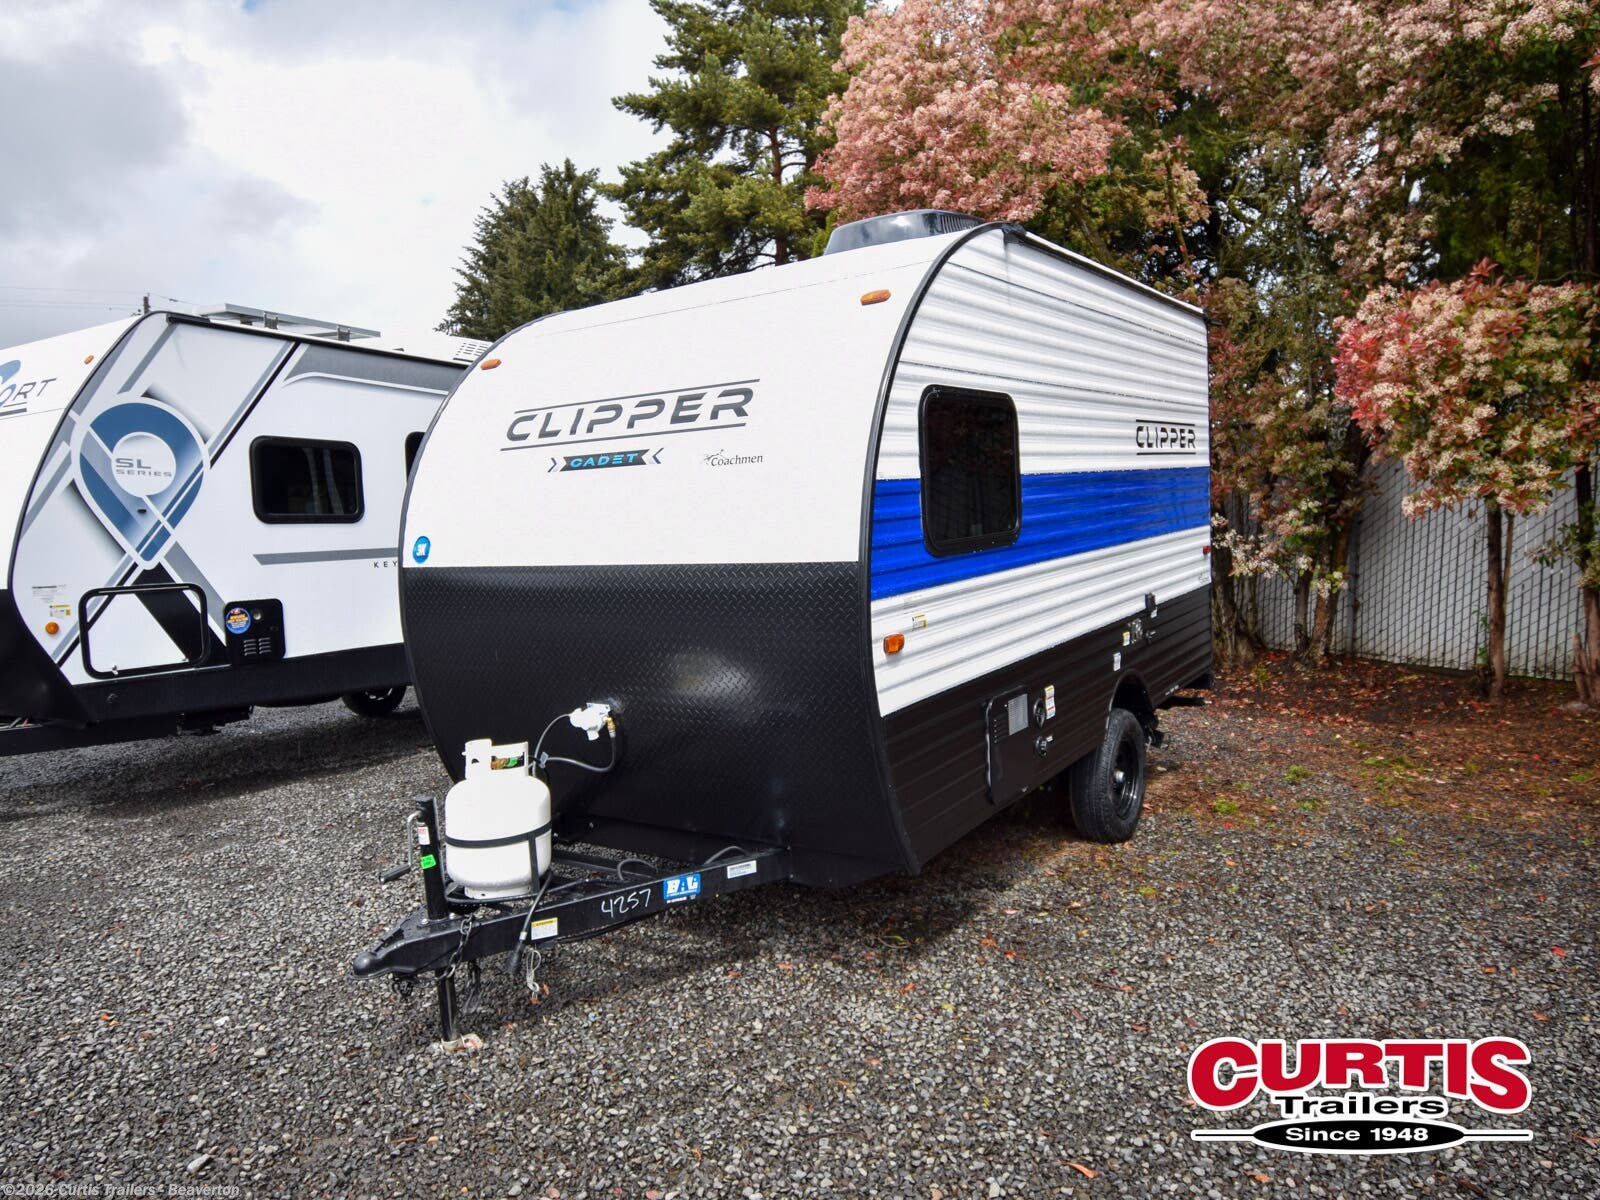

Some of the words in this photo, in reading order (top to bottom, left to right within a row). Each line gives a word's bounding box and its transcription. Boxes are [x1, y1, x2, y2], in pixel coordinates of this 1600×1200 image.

[506, 387, 755, 442] CLIPPER
[1136, 425, 1196, 449] CLIPPER
[115, 457, 152, 469] SL
[569, 452, 639, 468] CADET
[710, 454, 764, 467] Coachmen
[115, 469, 172, 477] SERIES
[601, 888, 651, 918] 4257
